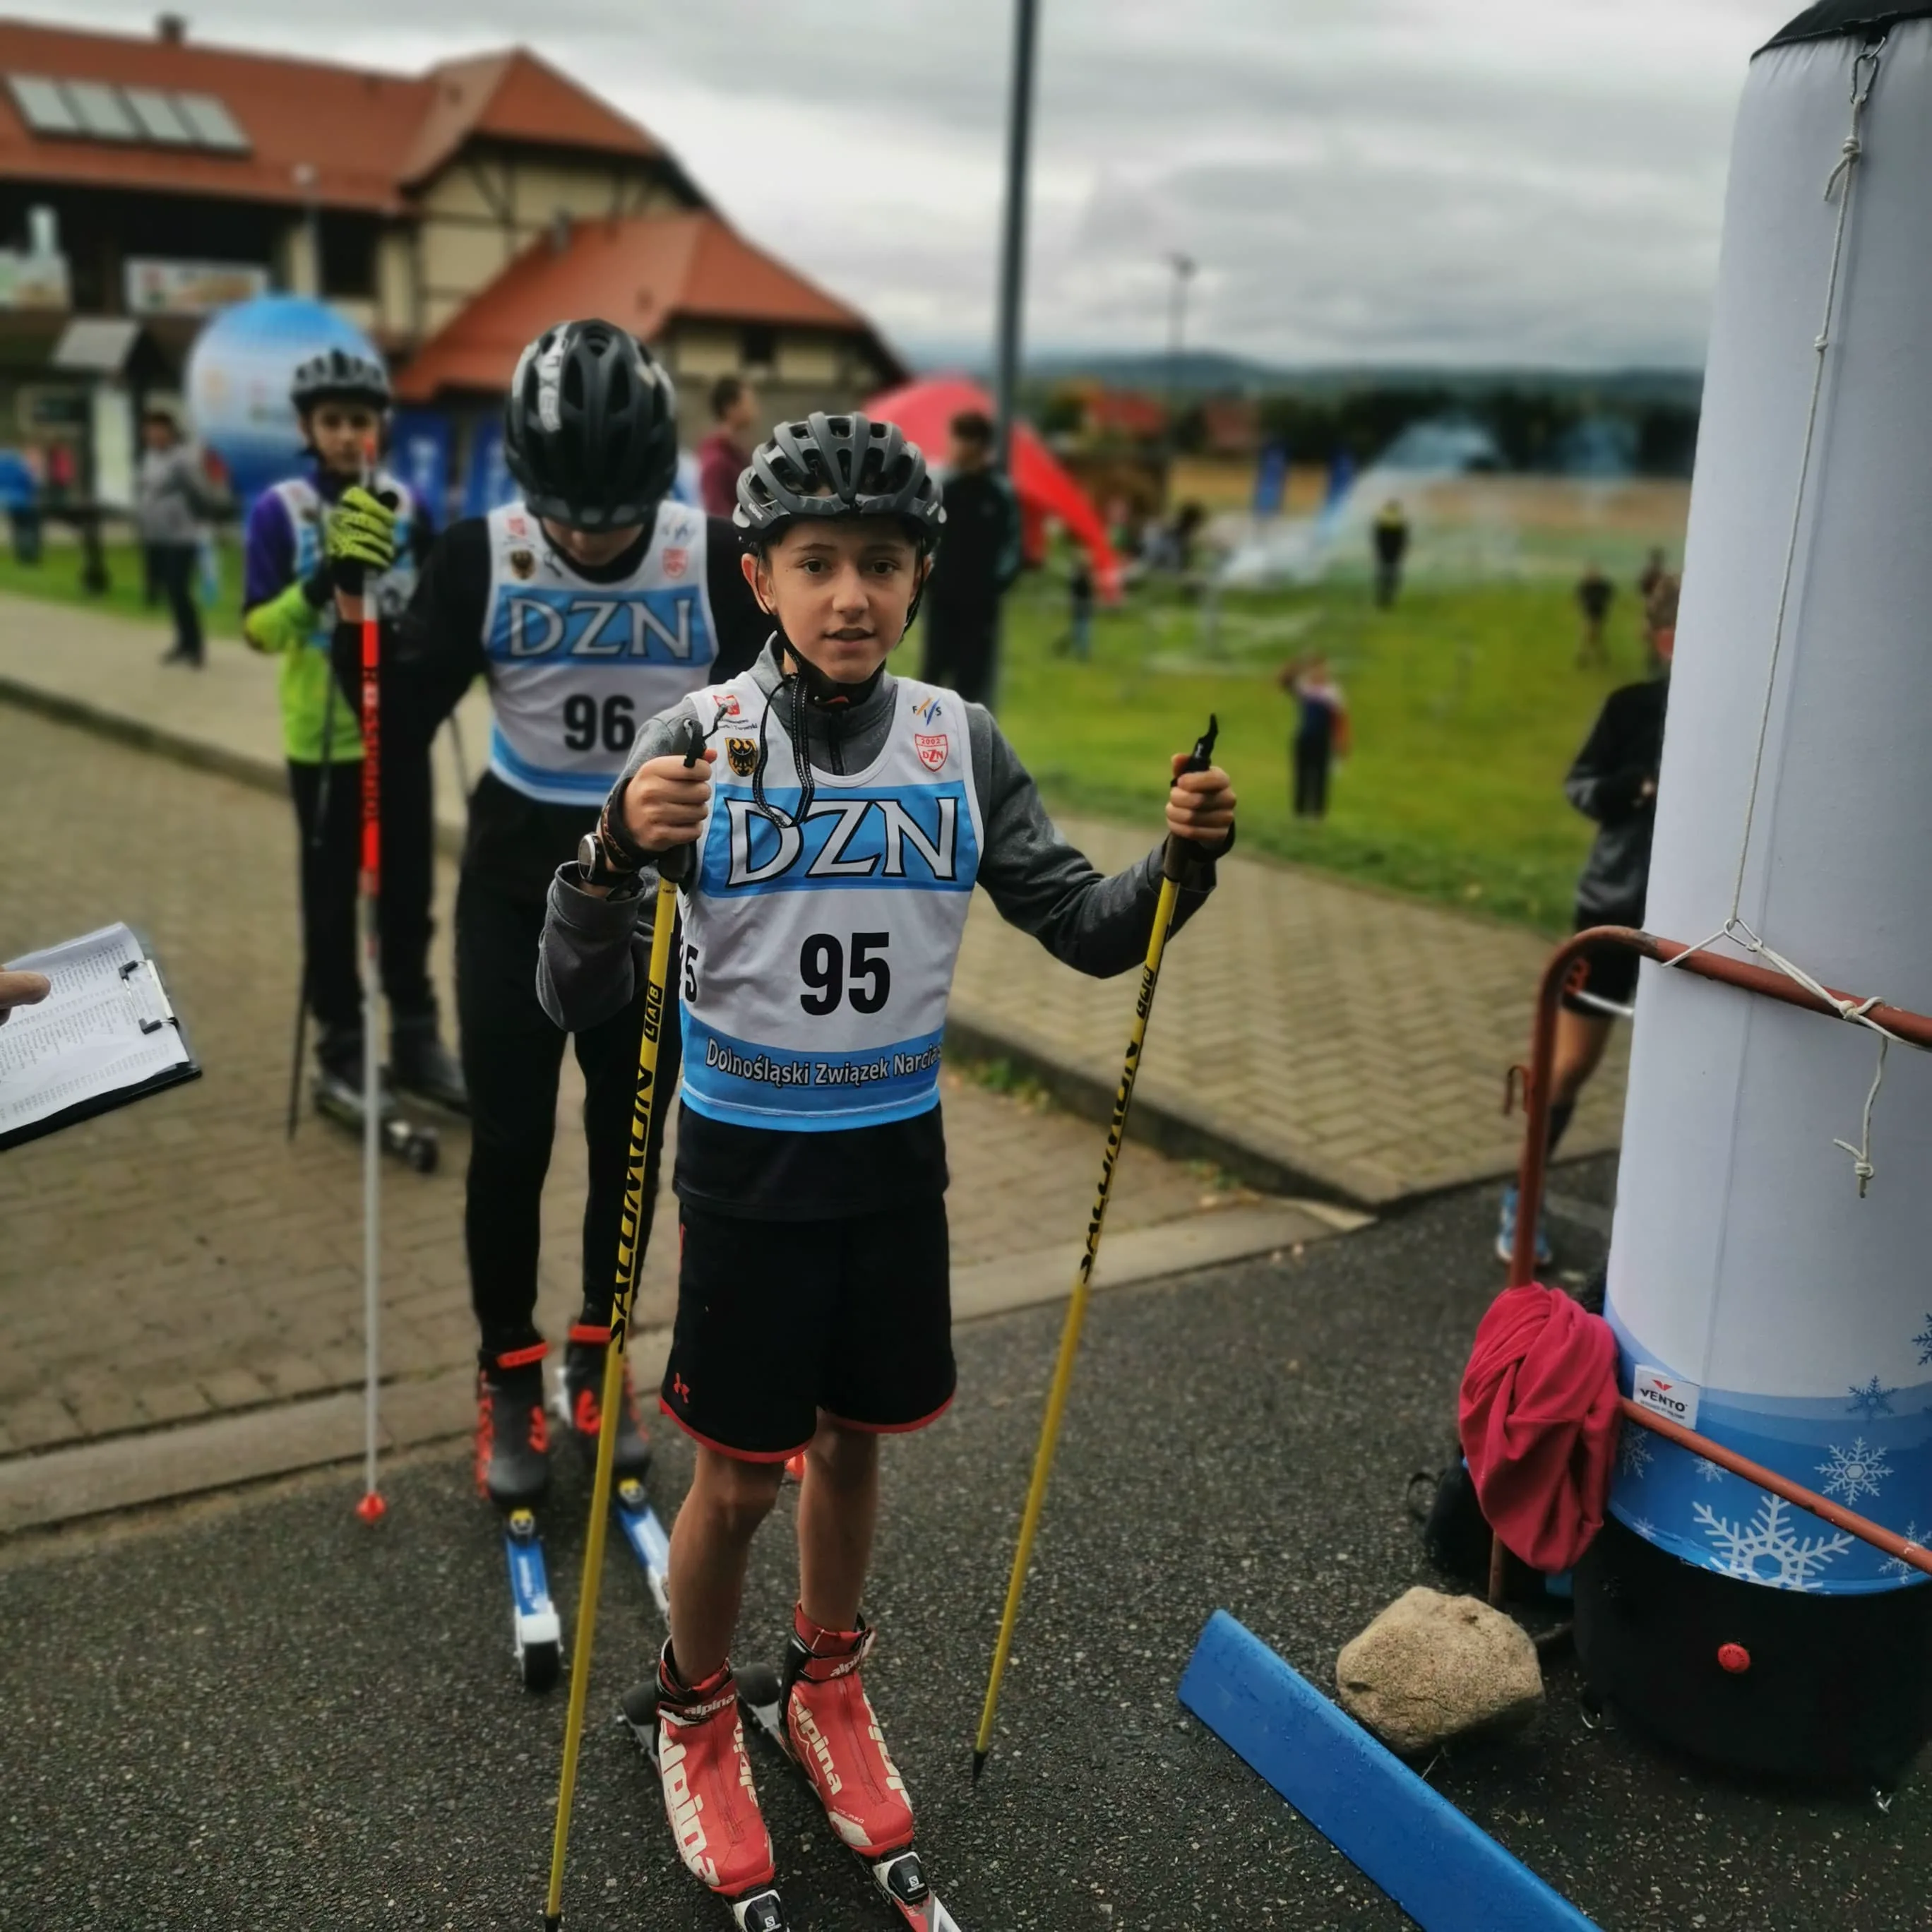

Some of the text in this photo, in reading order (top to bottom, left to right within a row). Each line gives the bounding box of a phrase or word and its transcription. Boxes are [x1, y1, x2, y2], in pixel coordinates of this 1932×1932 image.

[506, 596, 693, 660] DZN
[564, 693, 636, 752] 96
[922, 749, 943, 762] DZN
[724, 797, 959, 888] DZN
[680, 936, 699, 1003] 5
[800, 932, 890, 1015] 95
[644, 984, 663, 1043] LAB
[705, 1037, 942, 1088] Dolnośląski Związek Narcia
[610, 1064, 654, 1354] SALOMON
[1640, 1388, 1686, 1412] VENTO
[684, 1693, 736, 1716] alpina
